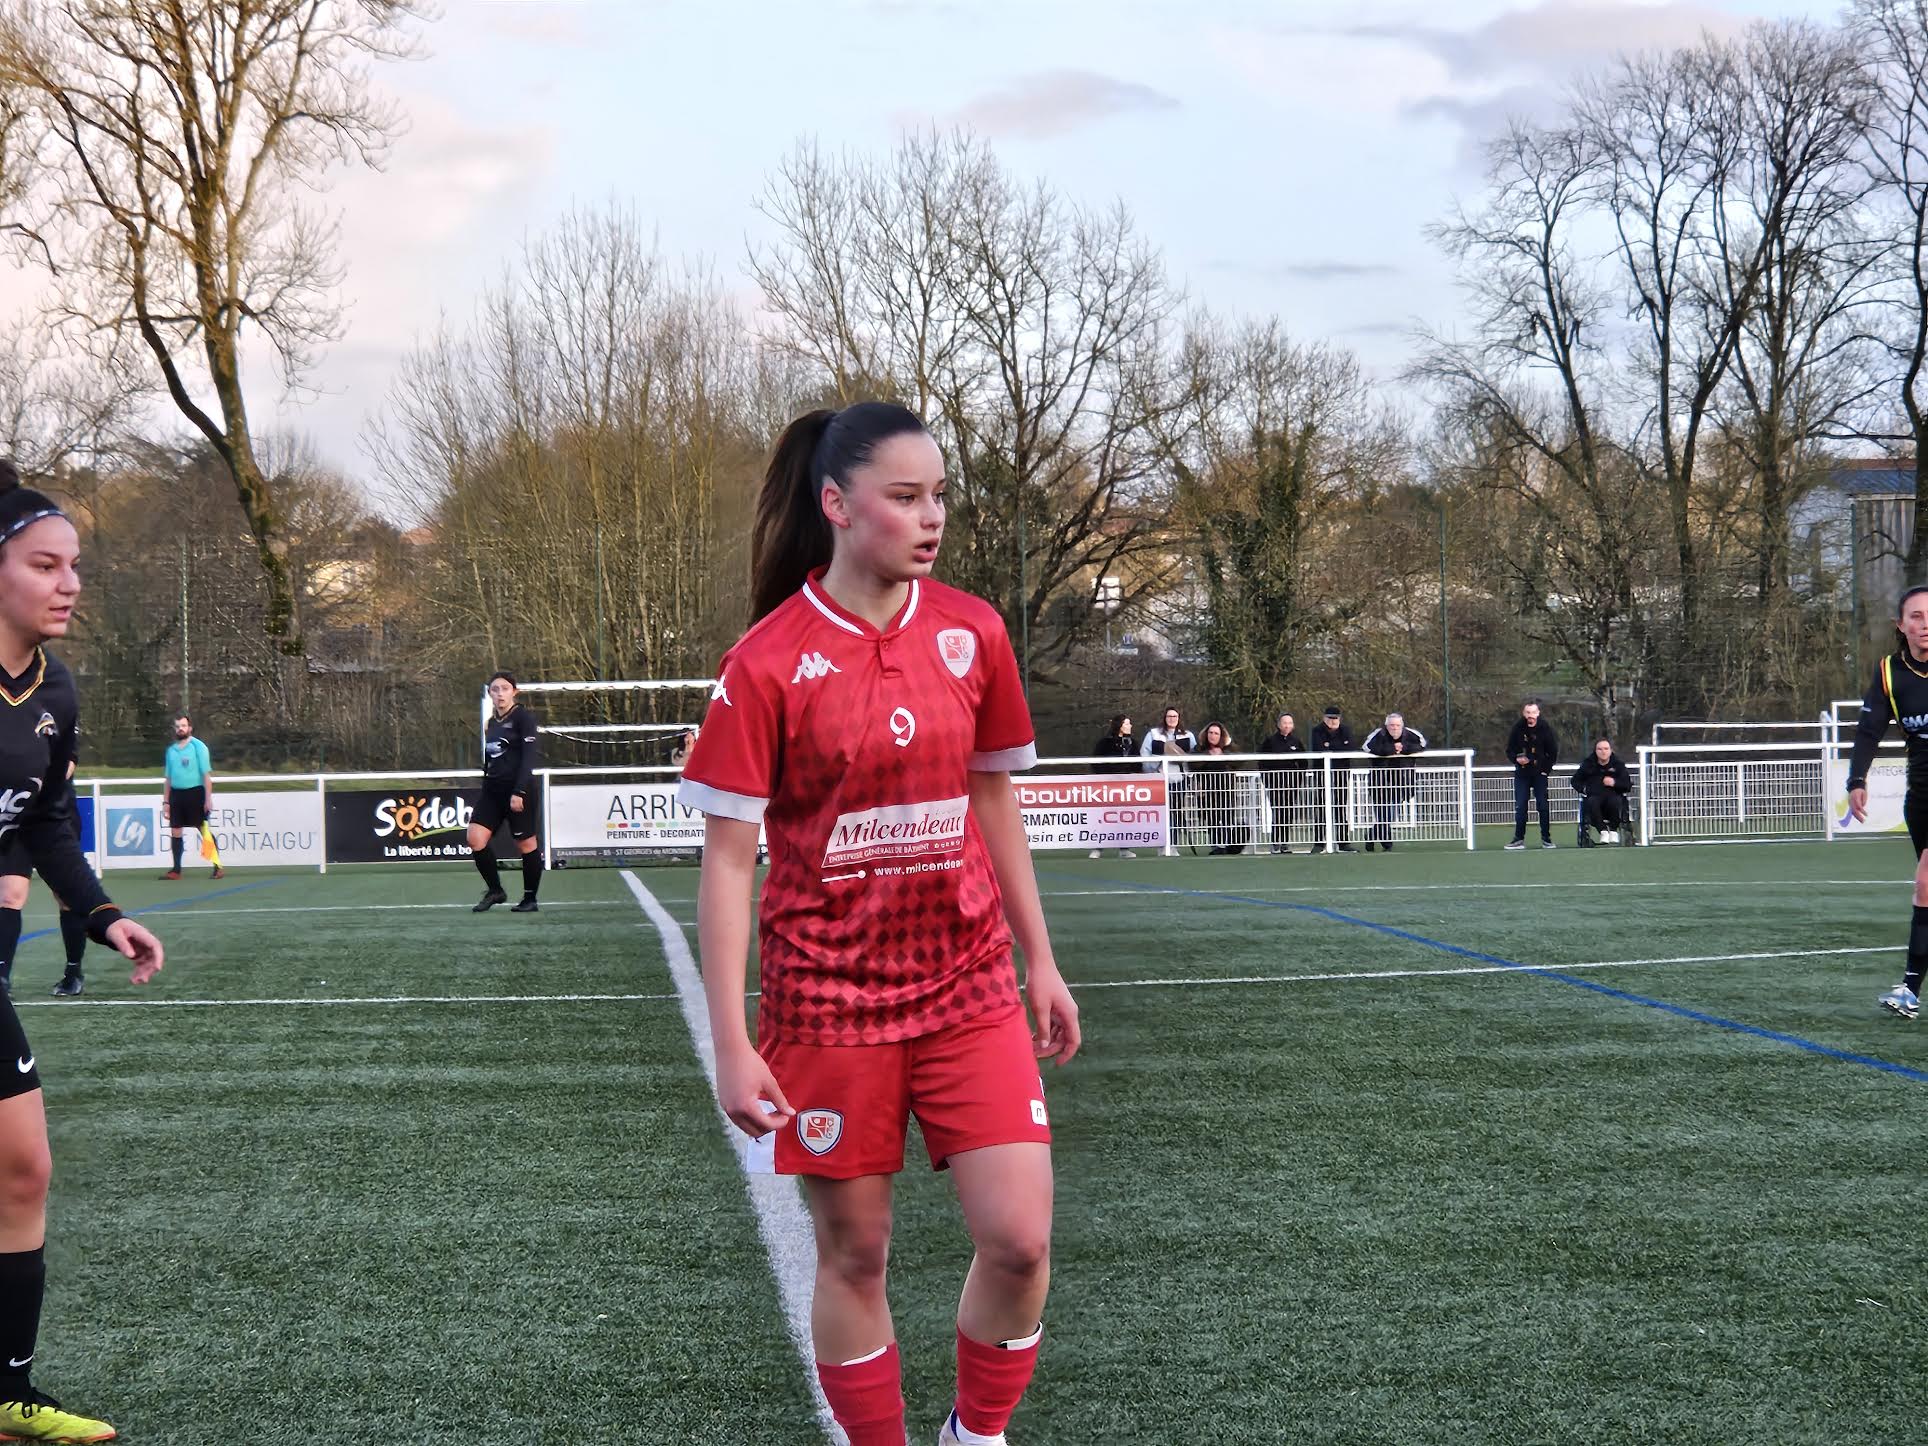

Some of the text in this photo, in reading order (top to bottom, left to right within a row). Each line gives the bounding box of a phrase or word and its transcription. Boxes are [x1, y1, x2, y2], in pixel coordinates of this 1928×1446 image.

[889, 706, 916, 748] 9
[1014, 785, 1152, 804] boutikinfo
[1098, 810, 1160, 824] .com
[606, 830, 651, 840] PEINTURE
[836, 814, 962, 847] Milcendeau
[1058, 832, 1074, 843] et
[1079, 830, 1160, 844] Dépannage
[384, 846, 397, 857] La
[398, 845, 432, 857] liberté
[434, 847, 441, 856] a
[443, 845, 456, 856] du
